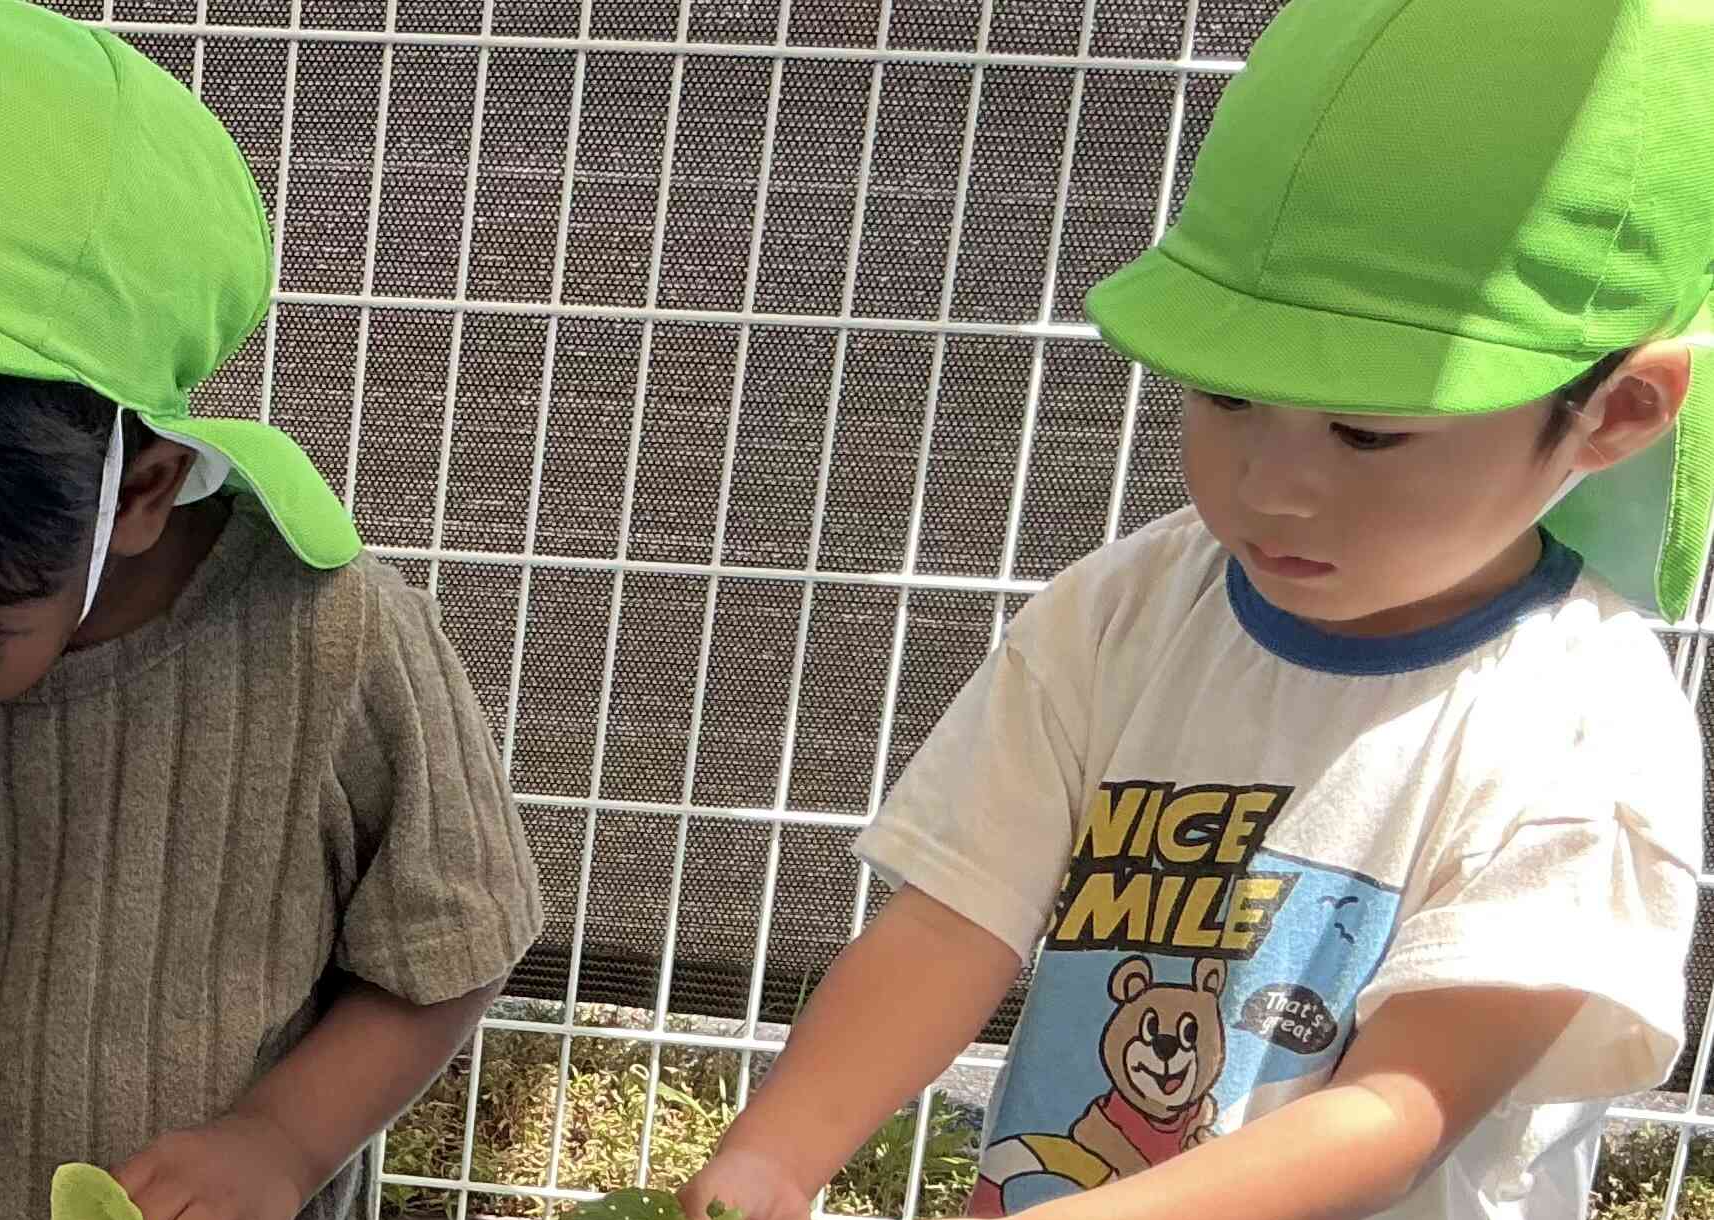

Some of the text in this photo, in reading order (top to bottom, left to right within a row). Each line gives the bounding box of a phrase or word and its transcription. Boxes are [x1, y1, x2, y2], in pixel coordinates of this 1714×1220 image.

[1070, 781, 1290, 868] NICE
[1050, 869, 1294, 956] MILE
[1259, 1015, 1313, 1043] great
[1264, 990, 1325, 1029] That's
